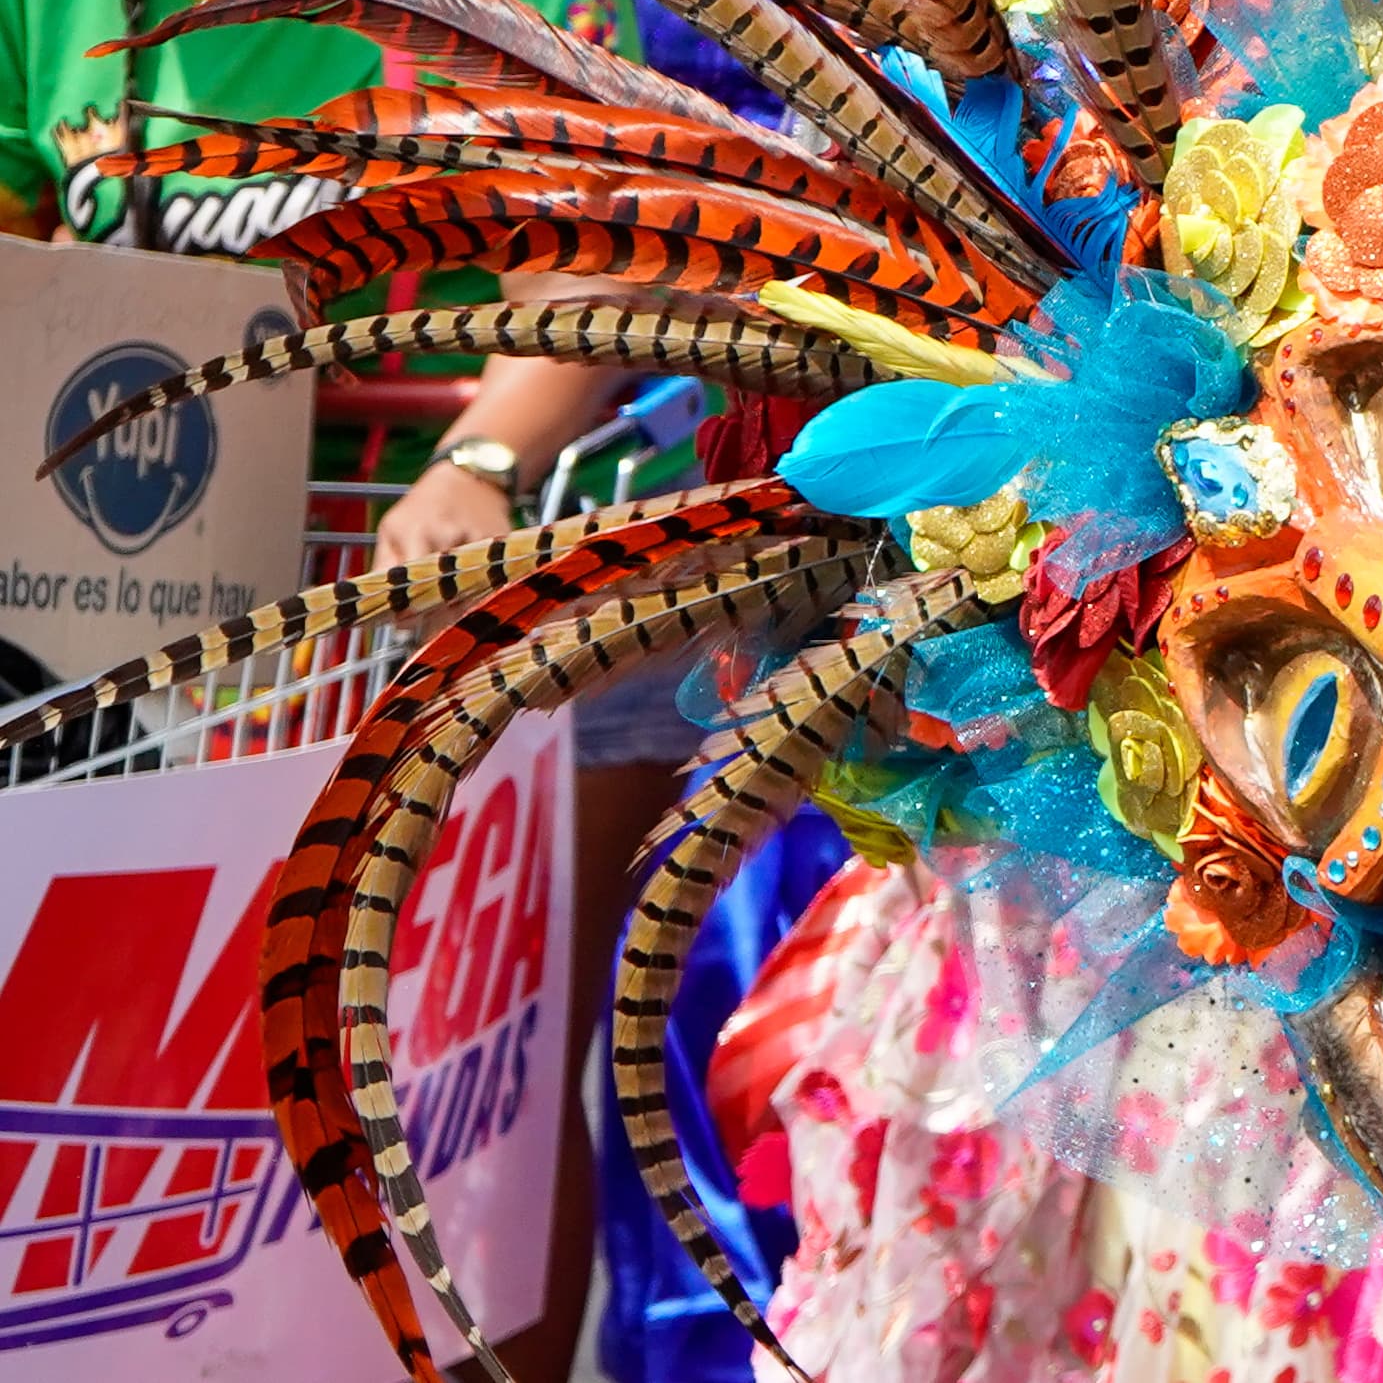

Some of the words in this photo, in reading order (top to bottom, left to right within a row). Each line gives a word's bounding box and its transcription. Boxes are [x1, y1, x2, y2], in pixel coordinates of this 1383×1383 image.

[88, 381, 183, 478] Yupi
[73, 575, 108, 613] es
[116, 566, 142, 614] lo
[149, 579, 202, 626] que
